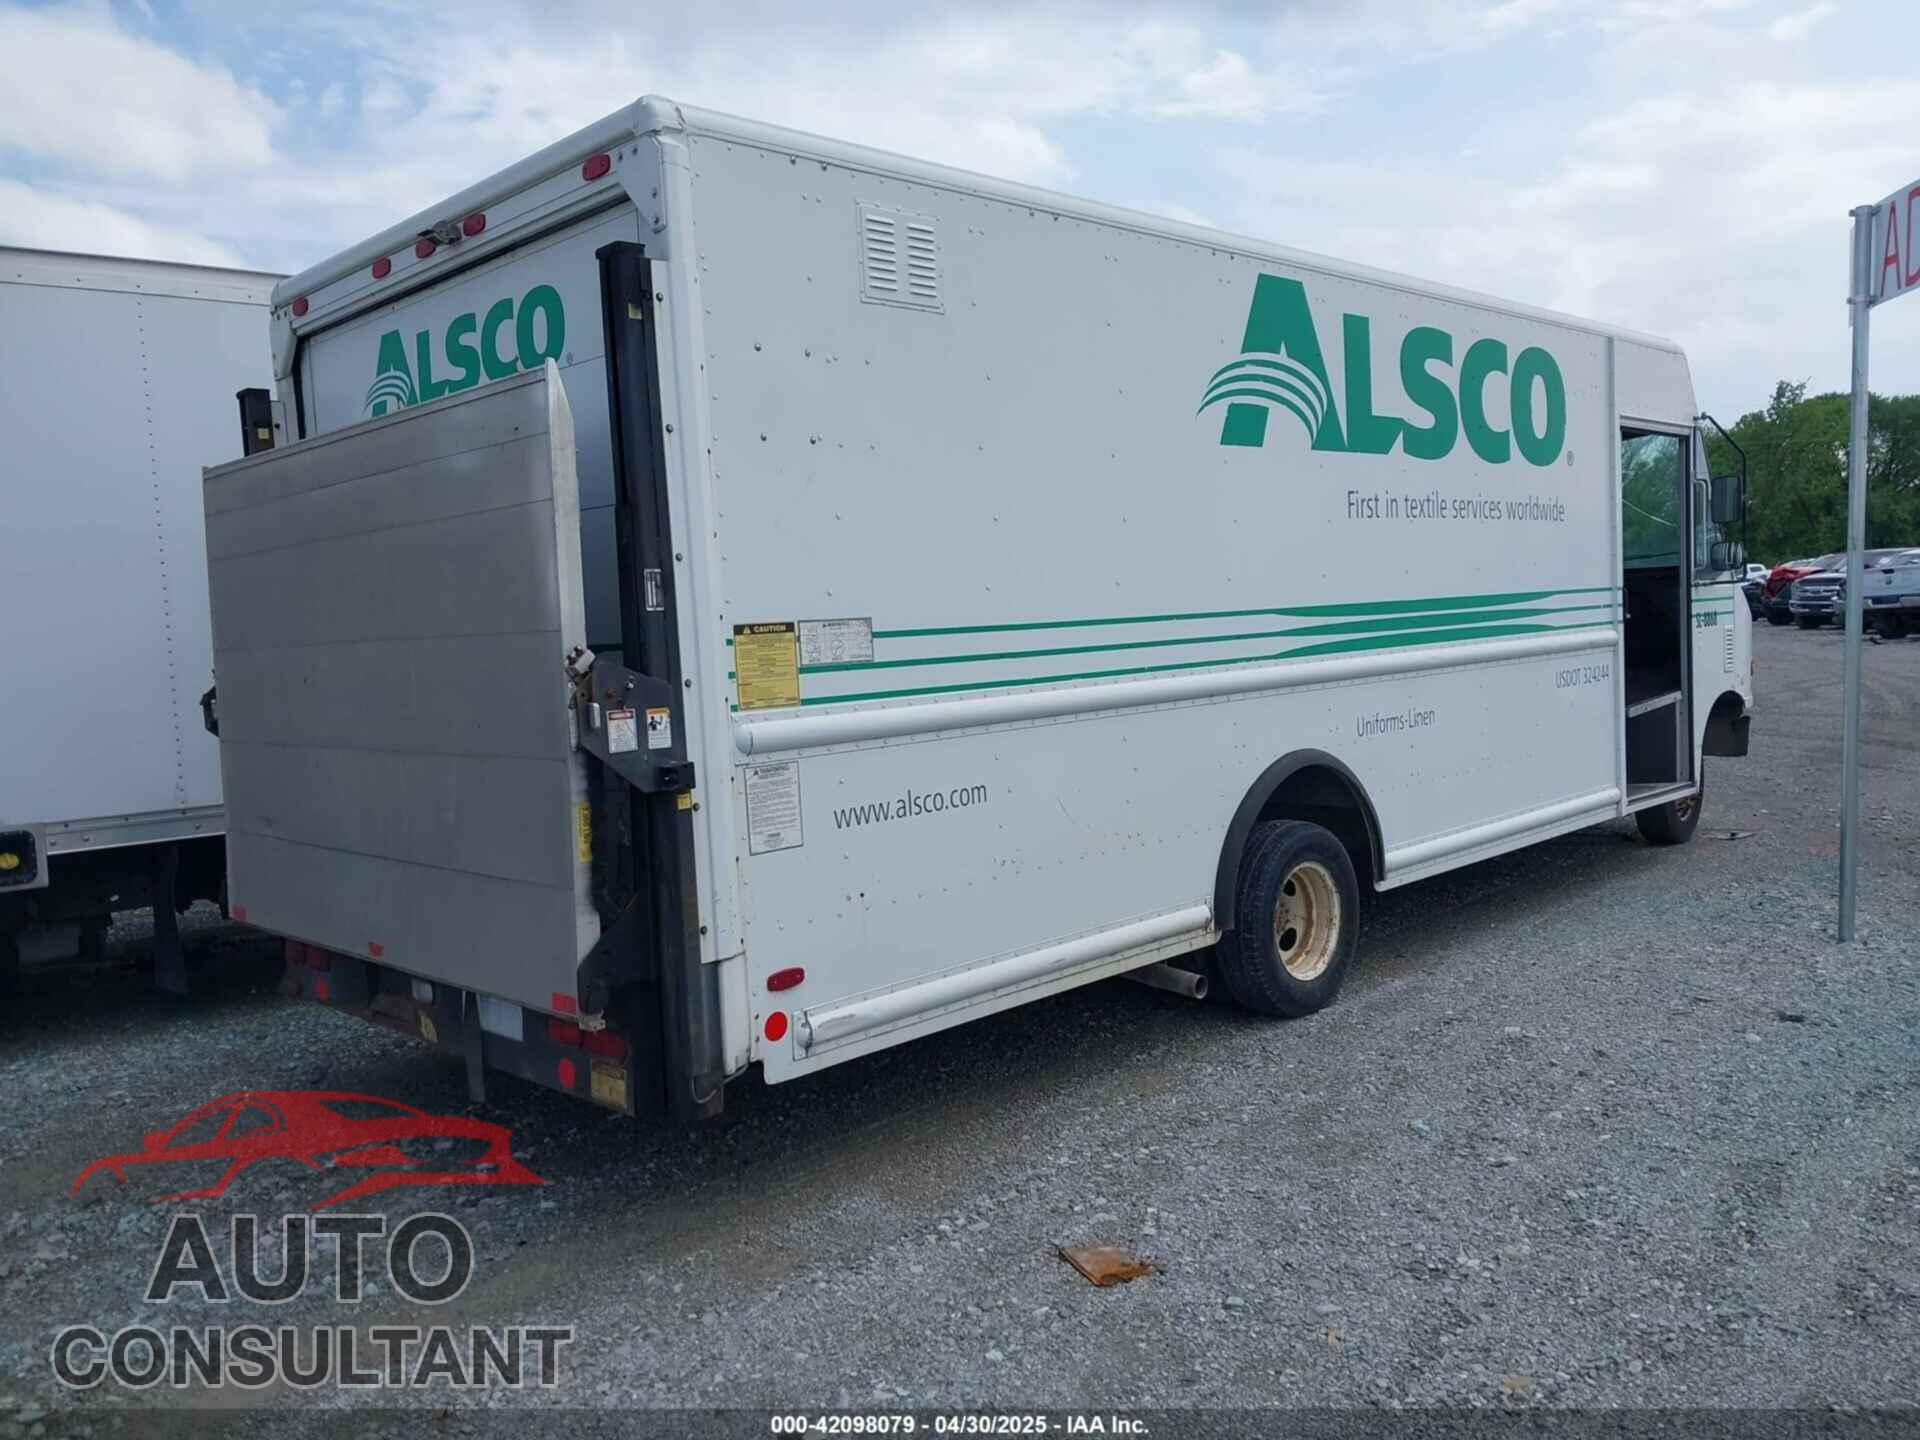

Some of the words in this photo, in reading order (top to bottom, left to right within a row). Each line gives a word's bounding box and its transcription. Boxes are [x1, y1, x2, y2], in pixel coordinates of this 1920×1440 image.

[363, 284, 565, 417] ALSCO
[1197, 272, 1567, 467] ALSCO
[1347, 490, 1380, 519] First
[1385, 490, 1399, 519] in
[1404, 489, 1448, 520] textile
[1452, 492, 1502, 521] services
[1505, 495, 1566, 523] worldwide
[1555, 668, 1581, 689] USDOT
[1356, 708, 1436, 737] Uniforms-Linen
[833, 784, 988, 830] www.alsco.com
